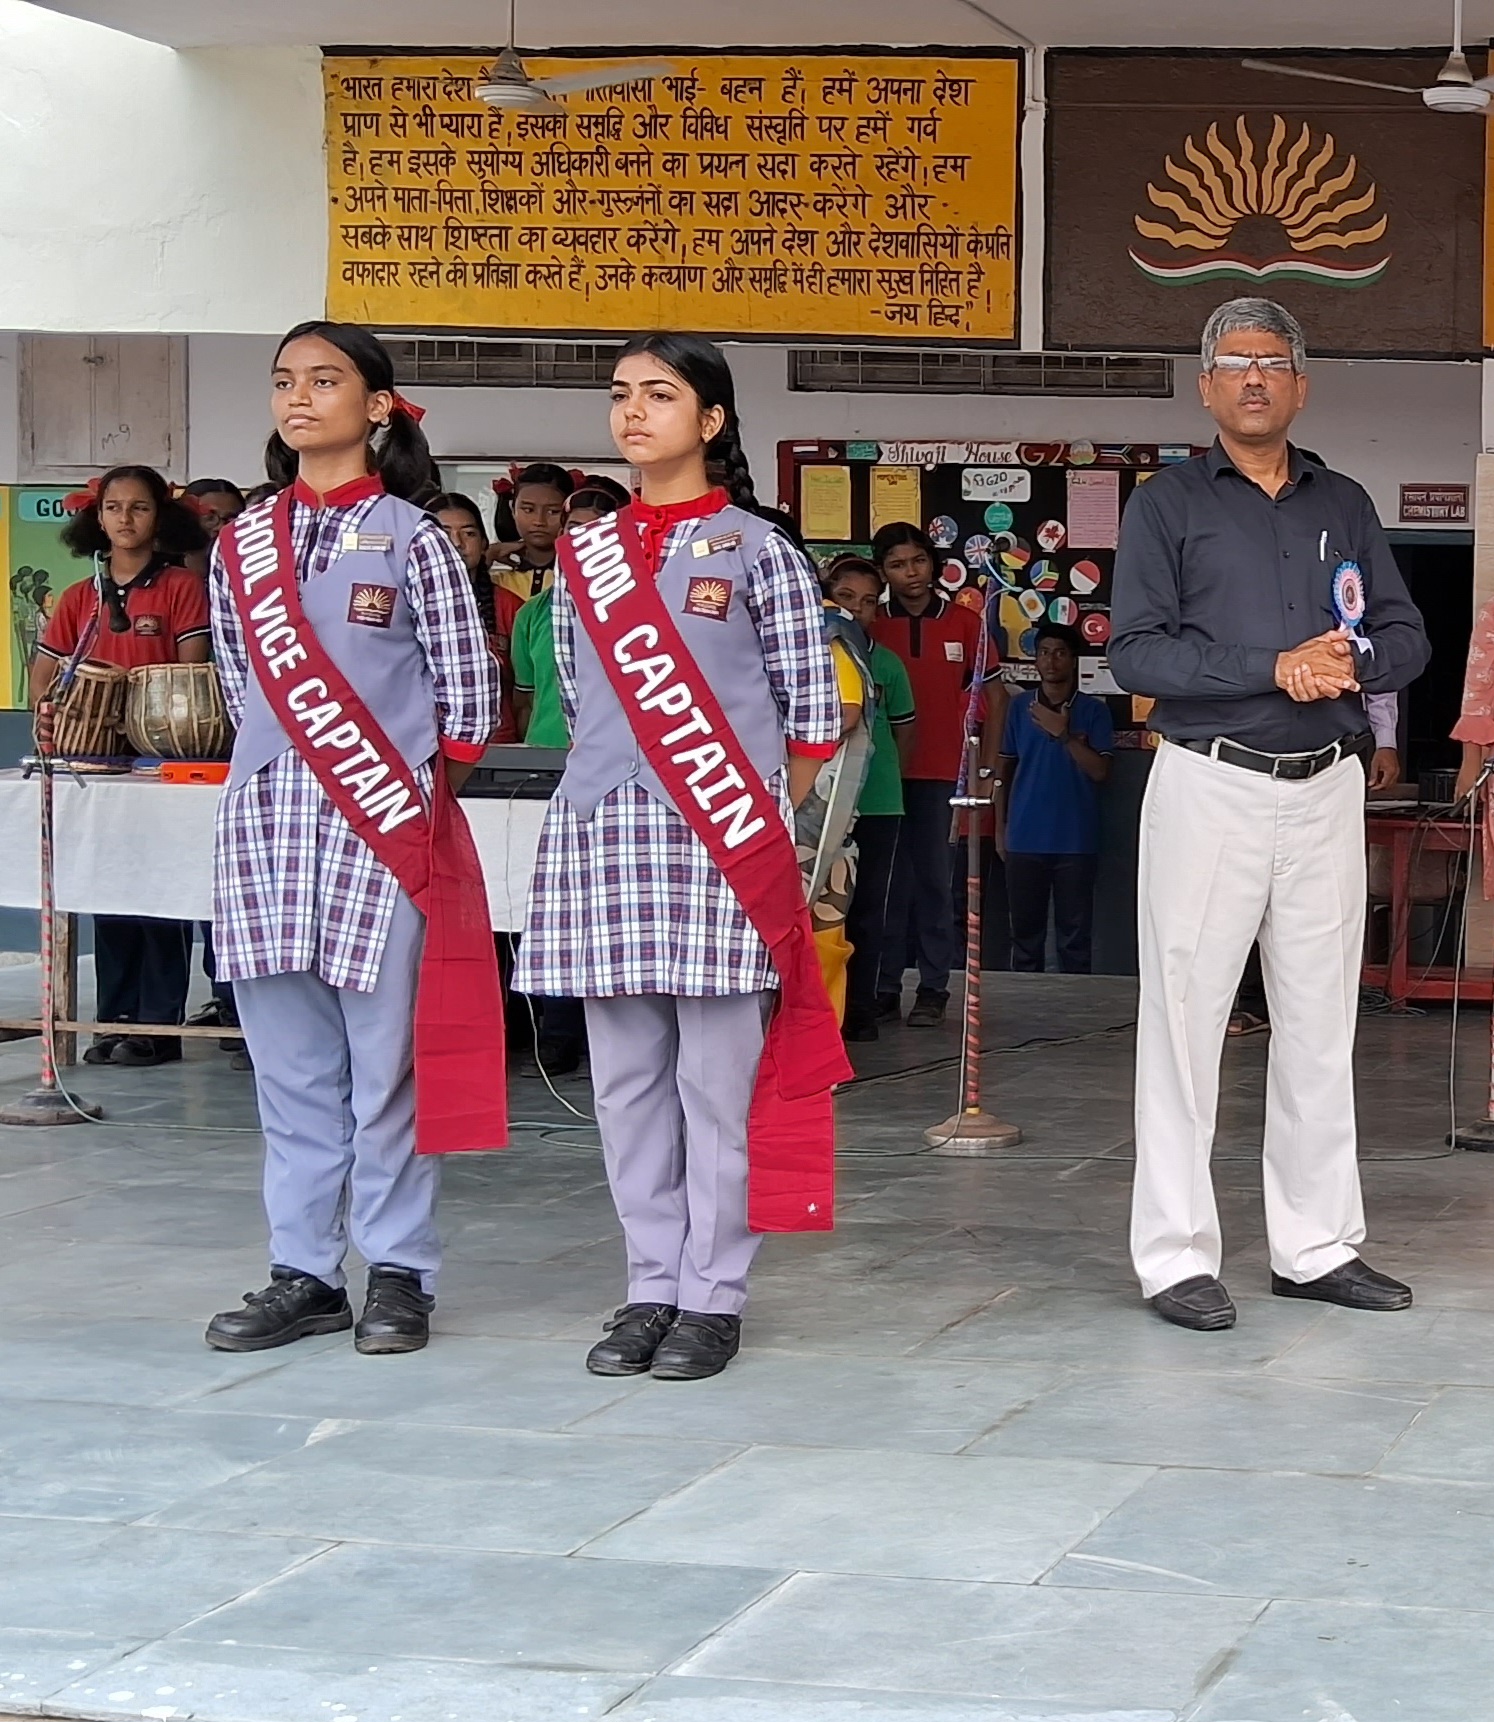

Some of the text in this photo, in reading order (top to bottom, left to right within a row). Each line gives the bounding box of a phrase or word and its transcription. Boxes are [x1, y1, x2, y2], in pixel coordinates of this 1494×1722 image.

[392, 77, 439, 100] हमारा
[442, 68, 473, 101] देश
[721, 78, 766, 103] बहन
[823, 69, 859, 104] हमें
[867, 78, 926, 104] अपना
[933, 70, 976, 106] देश
[340, 104, 942, 143] प्राण से भी प्यारा और विविध पर हमें गर्व
[369, 142, 971, 183] हम इसके सुयोग्य अधिकारी बनने का प्रयत्न सदा करते हम
[345, 179, 388, 212] अपने
[669, 191, 696, 216] का
[702, 192, 740, 216] सदा
[885, 182, 936, 220] और
[340, 218, 966, 259] सबके साथ का व्यवहार हम अपने देश और देशवासियों
[343, 262, 400, 286] वफादार
[408, 256, 443, 287] रहने
[446, 255, 469, 286] की
[472, 254, 521, 288] प्रतिज्ञा
[526, 256, 565, 289] करते
[596, 258, 636, 290] उनके
[642, 266, 707, 291] कल्याण
[713, 257, 744, 292] और
[827, 269, 873, 295] हमारा
[876, 269, 915, 299] सुख
[919, 262, 963, 297] निहित
[963, 442, 1013, 464] House
[36, 498, 79, 518] GO
[1450, 505, 1465, 518] LAB
[250, 586, 307, 679] VICE
[287, 677, 422, 835] CAPTAIN
[611, 623, 767, 851] CAPTAIN
